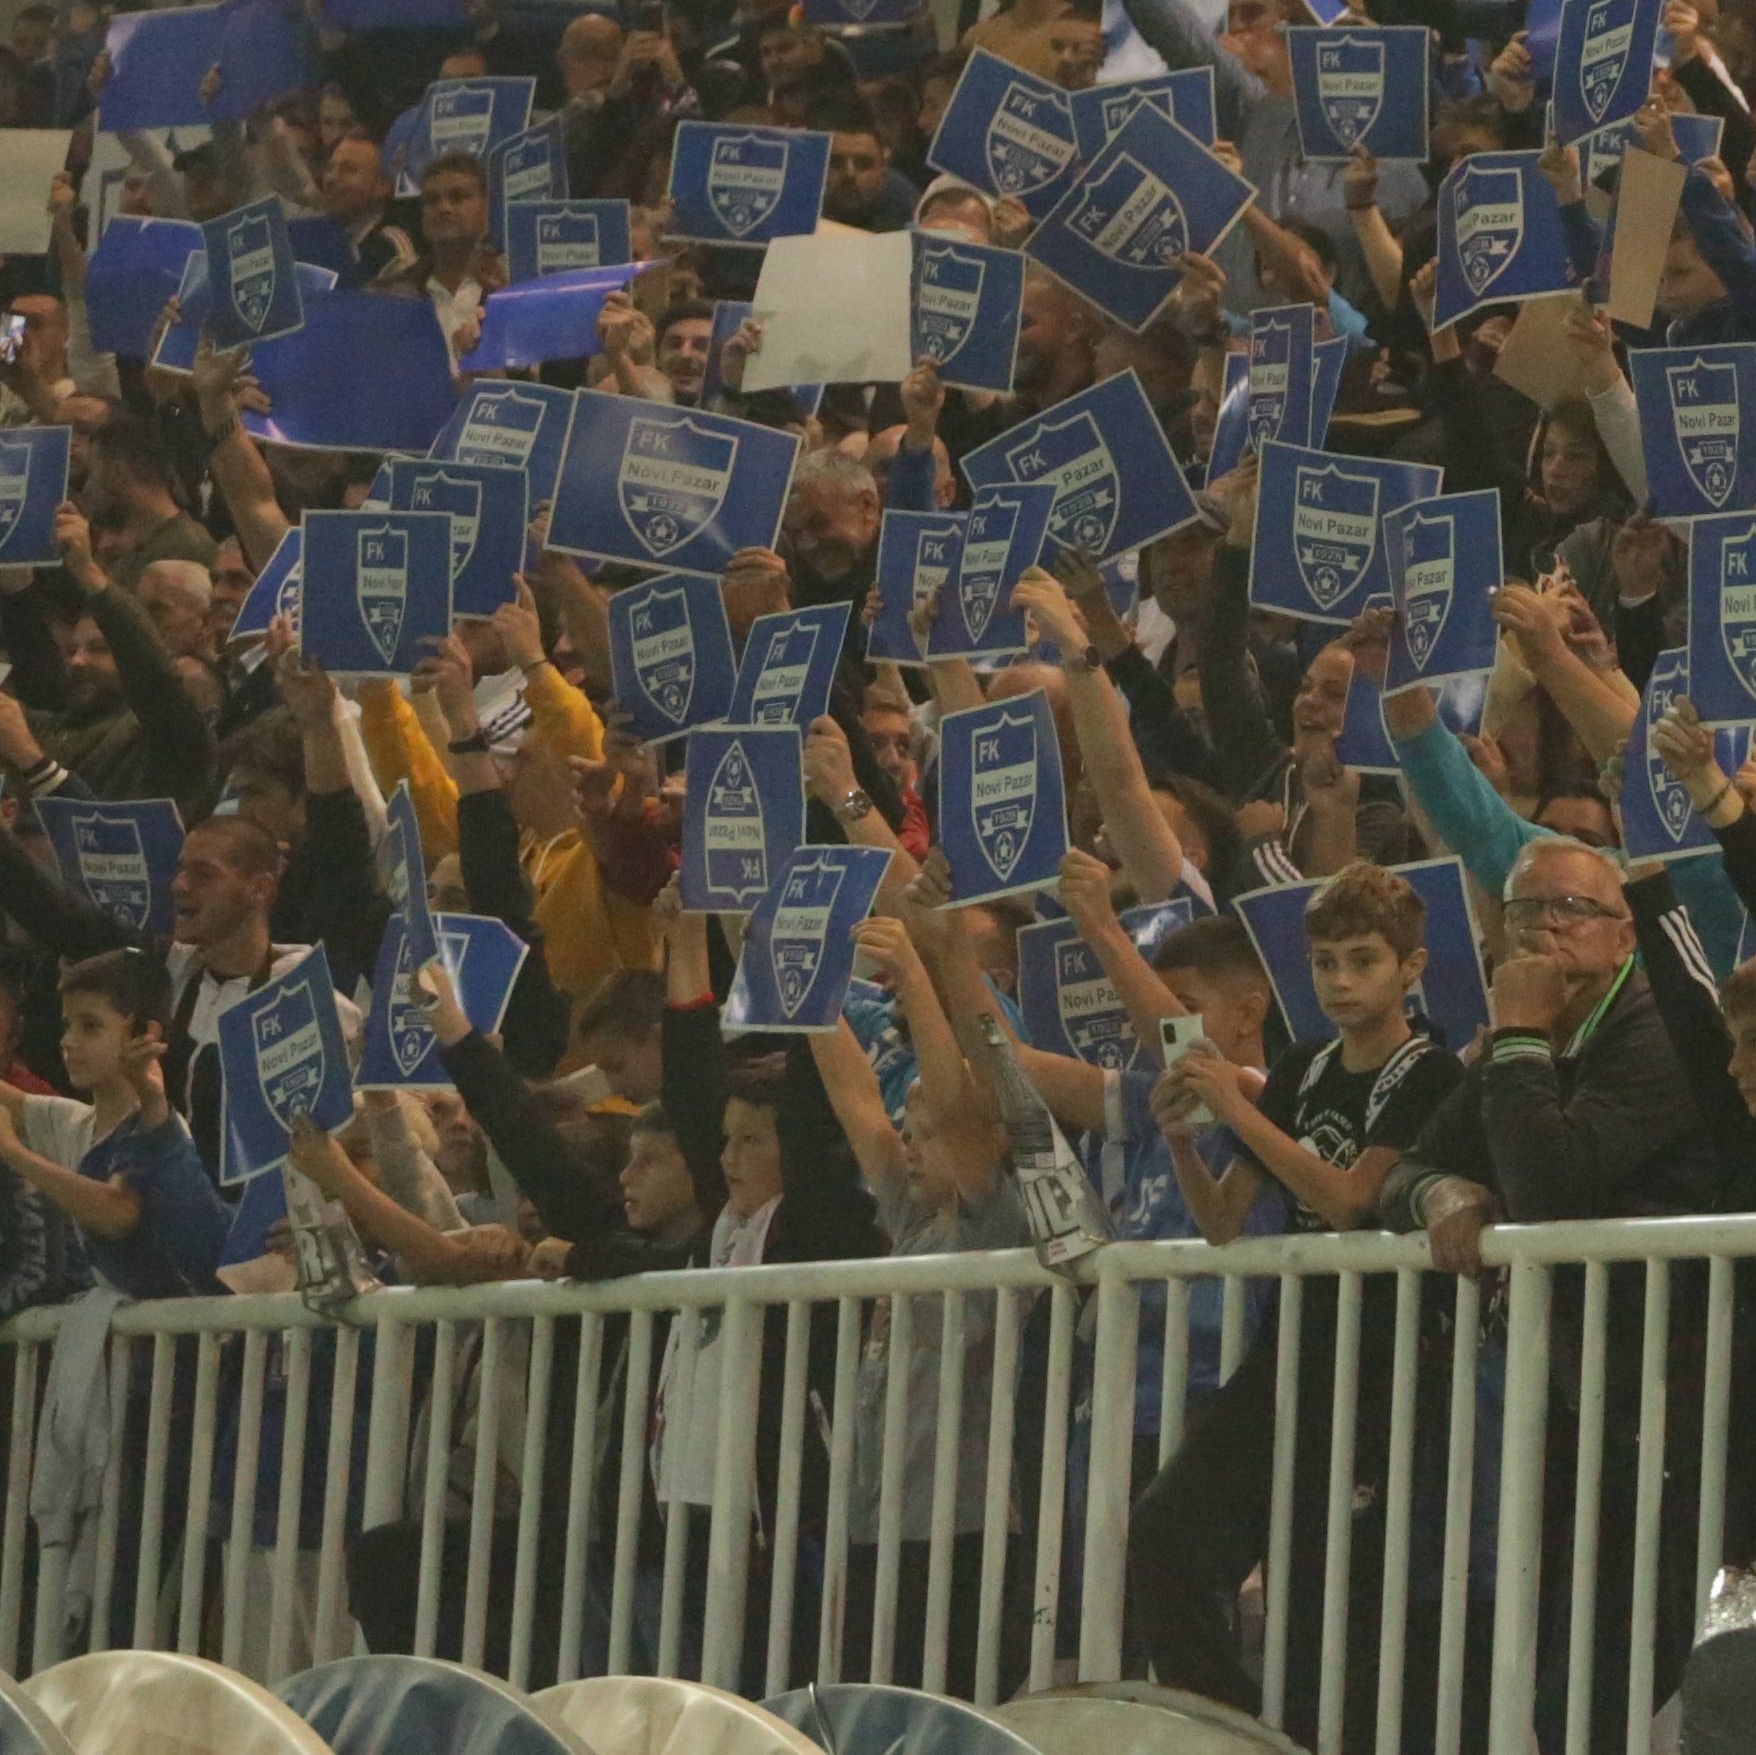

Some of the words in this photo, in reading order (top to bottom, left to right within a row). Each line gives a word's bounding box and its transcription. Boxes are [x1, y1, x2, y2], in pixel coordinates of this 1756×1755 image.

[1592, 12, 1606, 30] FK
[1322, 51, 1341, 68] FK
[1010, 95, 1038, 117] FK
[1125, 185, 1157, 220] Pazar
[1080, 206, 1105, 232] FK
[1473, 209, 1517, 226] Pazar
[937, 293, 972, 311] Pazar
[1677, 378, 1700, 398] FK
[477, 402, 499, 421] FK
[1679, 414, 1704, 429] Novi
[1707, 411, 1736, 428] Pazar
[492, 434, 527, 451] Pazar
[1018, 449, 1046, 475] FK
[1062, 456, 1106, 486] Pazar
[626, 462, 661, 481] Novi
[665, 470, 720, 492] Pazar
[1303, 480, 1323, 502] FK
[1298, 513, 1323, 530] Novi
[1327, 518, 1368, 539] Pazar
[366, 541, 386, 561] FK
[924, 541, 944, 559] FK
[1727, 552, 1748, 576] FK
[1417, 566, 1448, 586] Pazar
[1725, 595, 1750, 613] Novi
[1652, 690, 1673, 711] FK
[979, 742, 1000, 762] FK
[976, 779, 1000, 796] Novi
[1004, 774, 1032, 793] Pazar
[1064, 952, 1086, 974] FK
[1063, 990, 1088, 1009] Novi
